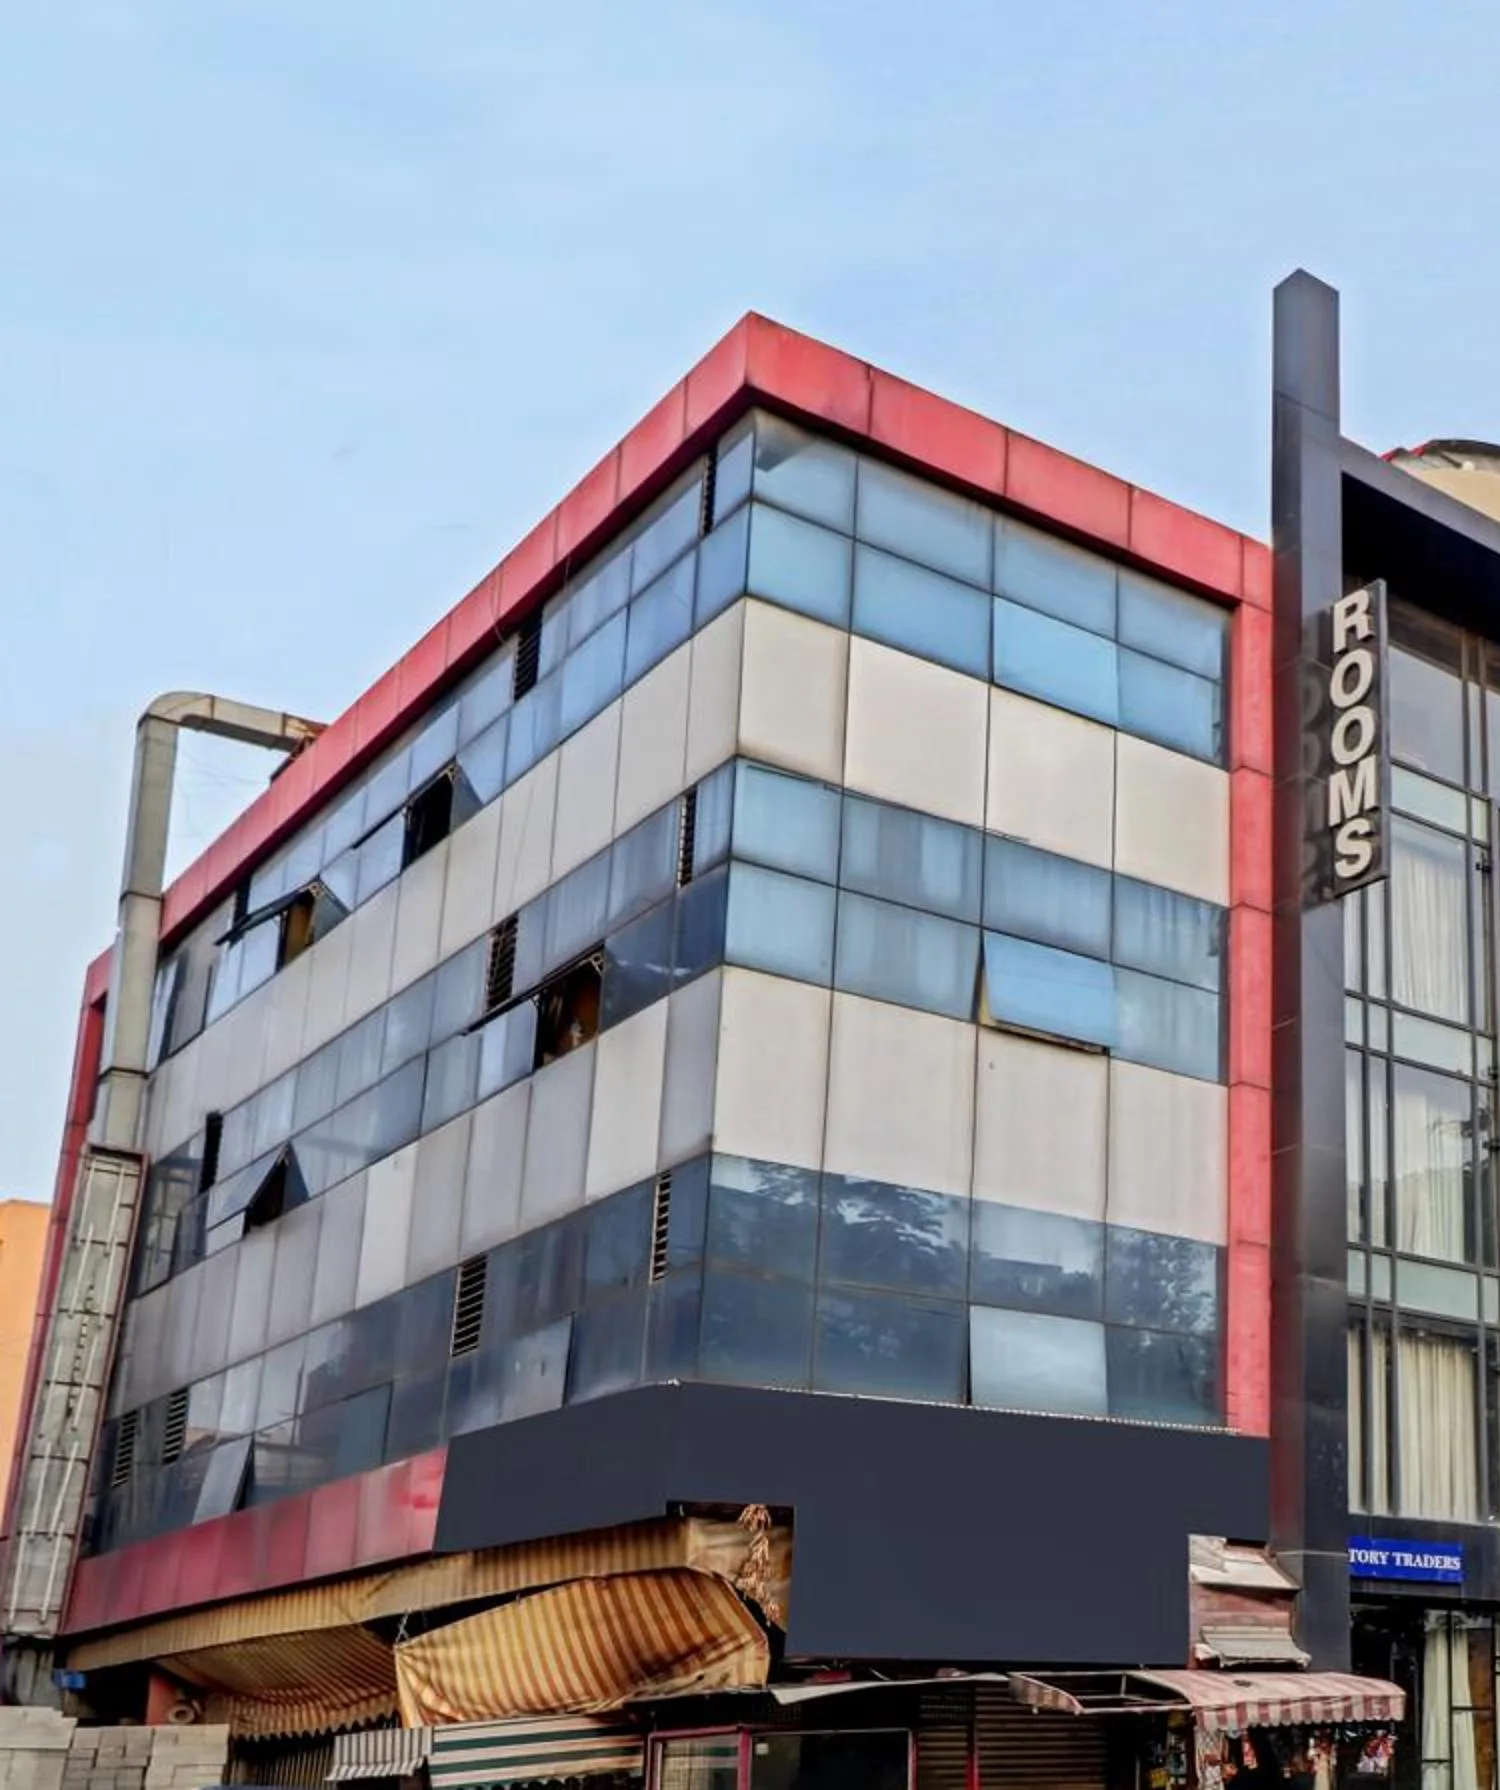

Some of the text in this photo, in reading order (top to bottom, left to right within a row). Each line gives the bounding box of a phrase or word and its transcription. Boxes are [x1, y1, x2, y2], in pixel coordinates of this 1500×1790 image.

[1329, 589, 1379, 879] ROOMS
[1347, 1548, 1461, 1571] TORY TRADERS
